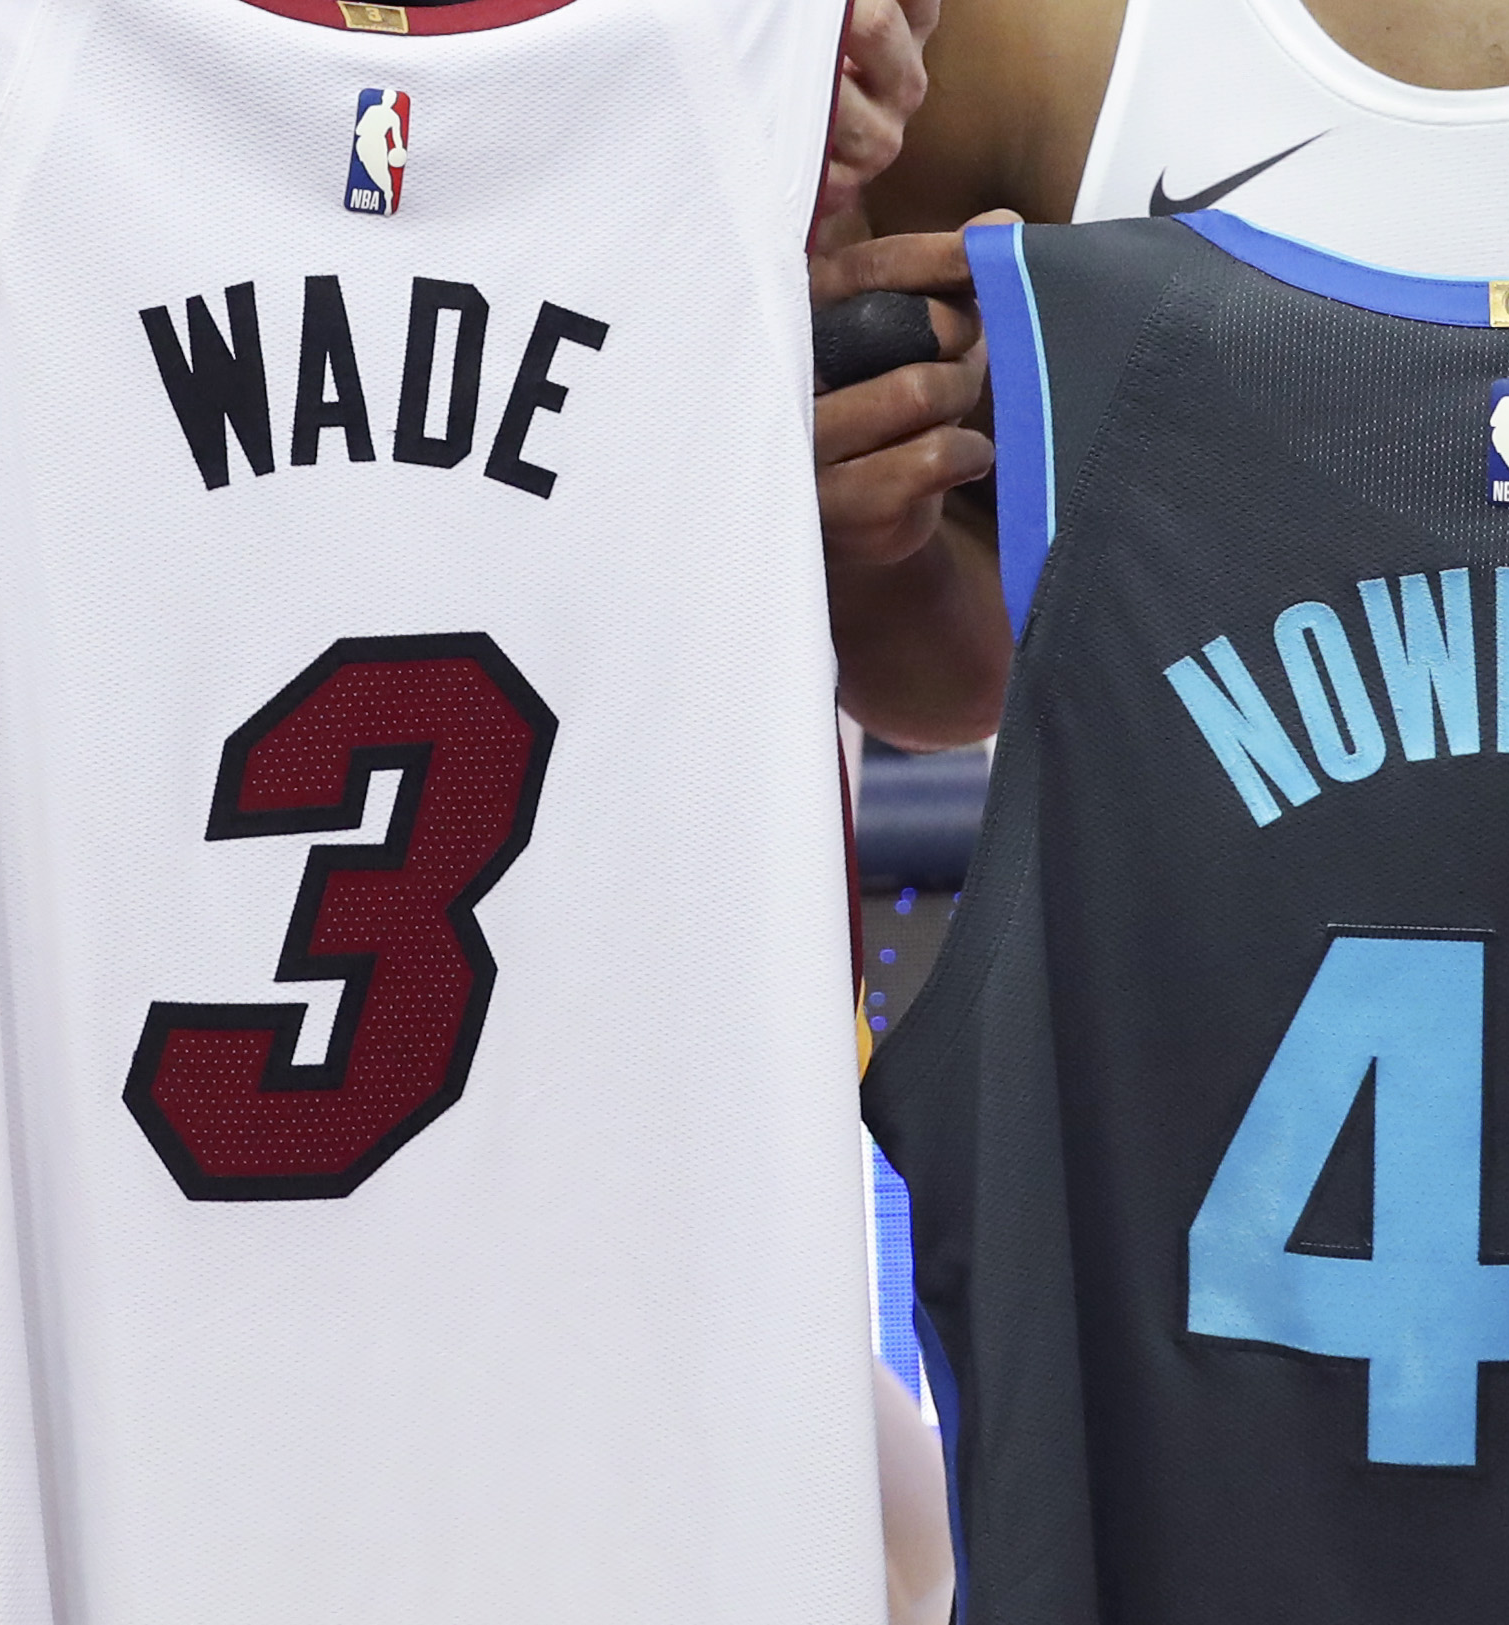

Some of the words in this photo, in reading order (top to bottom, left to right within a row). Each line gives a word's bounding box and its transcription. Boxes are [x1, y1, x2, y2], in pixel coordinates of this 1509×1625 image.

[349, 187, 380, 211] NBA
[138, 274, 610, 500] WADE
[121, 630, 560, 1202] 3
